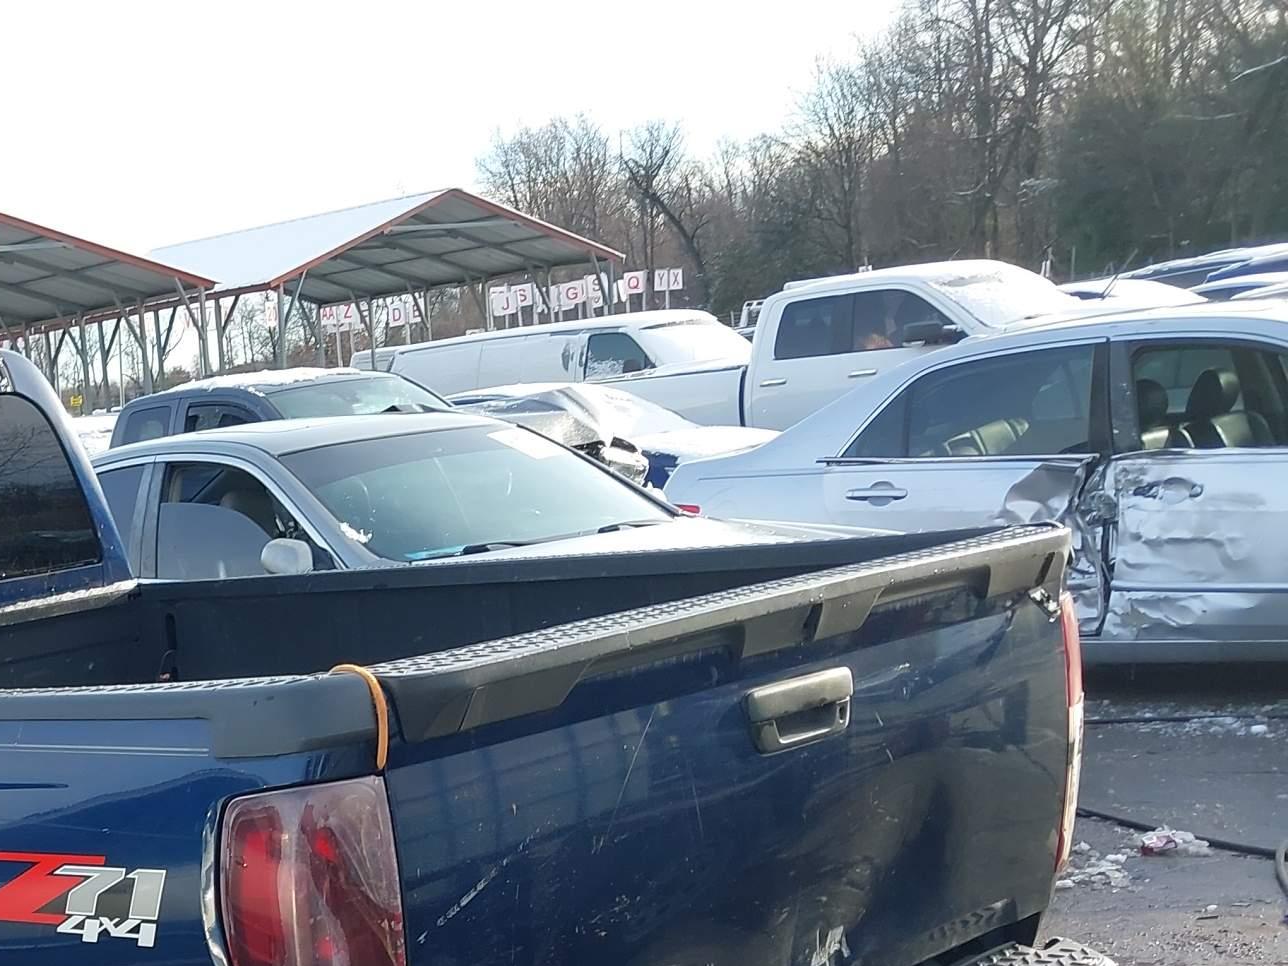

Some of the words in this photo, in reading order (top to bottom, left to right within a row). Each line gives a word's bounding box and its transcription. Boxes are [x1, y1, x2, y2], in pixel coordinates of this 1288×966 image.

[627, 276, 640, 290] Q
[657, 273, 665, 287] Y
[671, 273, 680, 287] X
[518, 288, 528, 303] S
[566, 286, 578, 300] G
[501, 296, 510, 311] J
[321, 308, 335, 320] AA
[343, 304, 353, 320] Z
[392, 307, 402, 322] D
